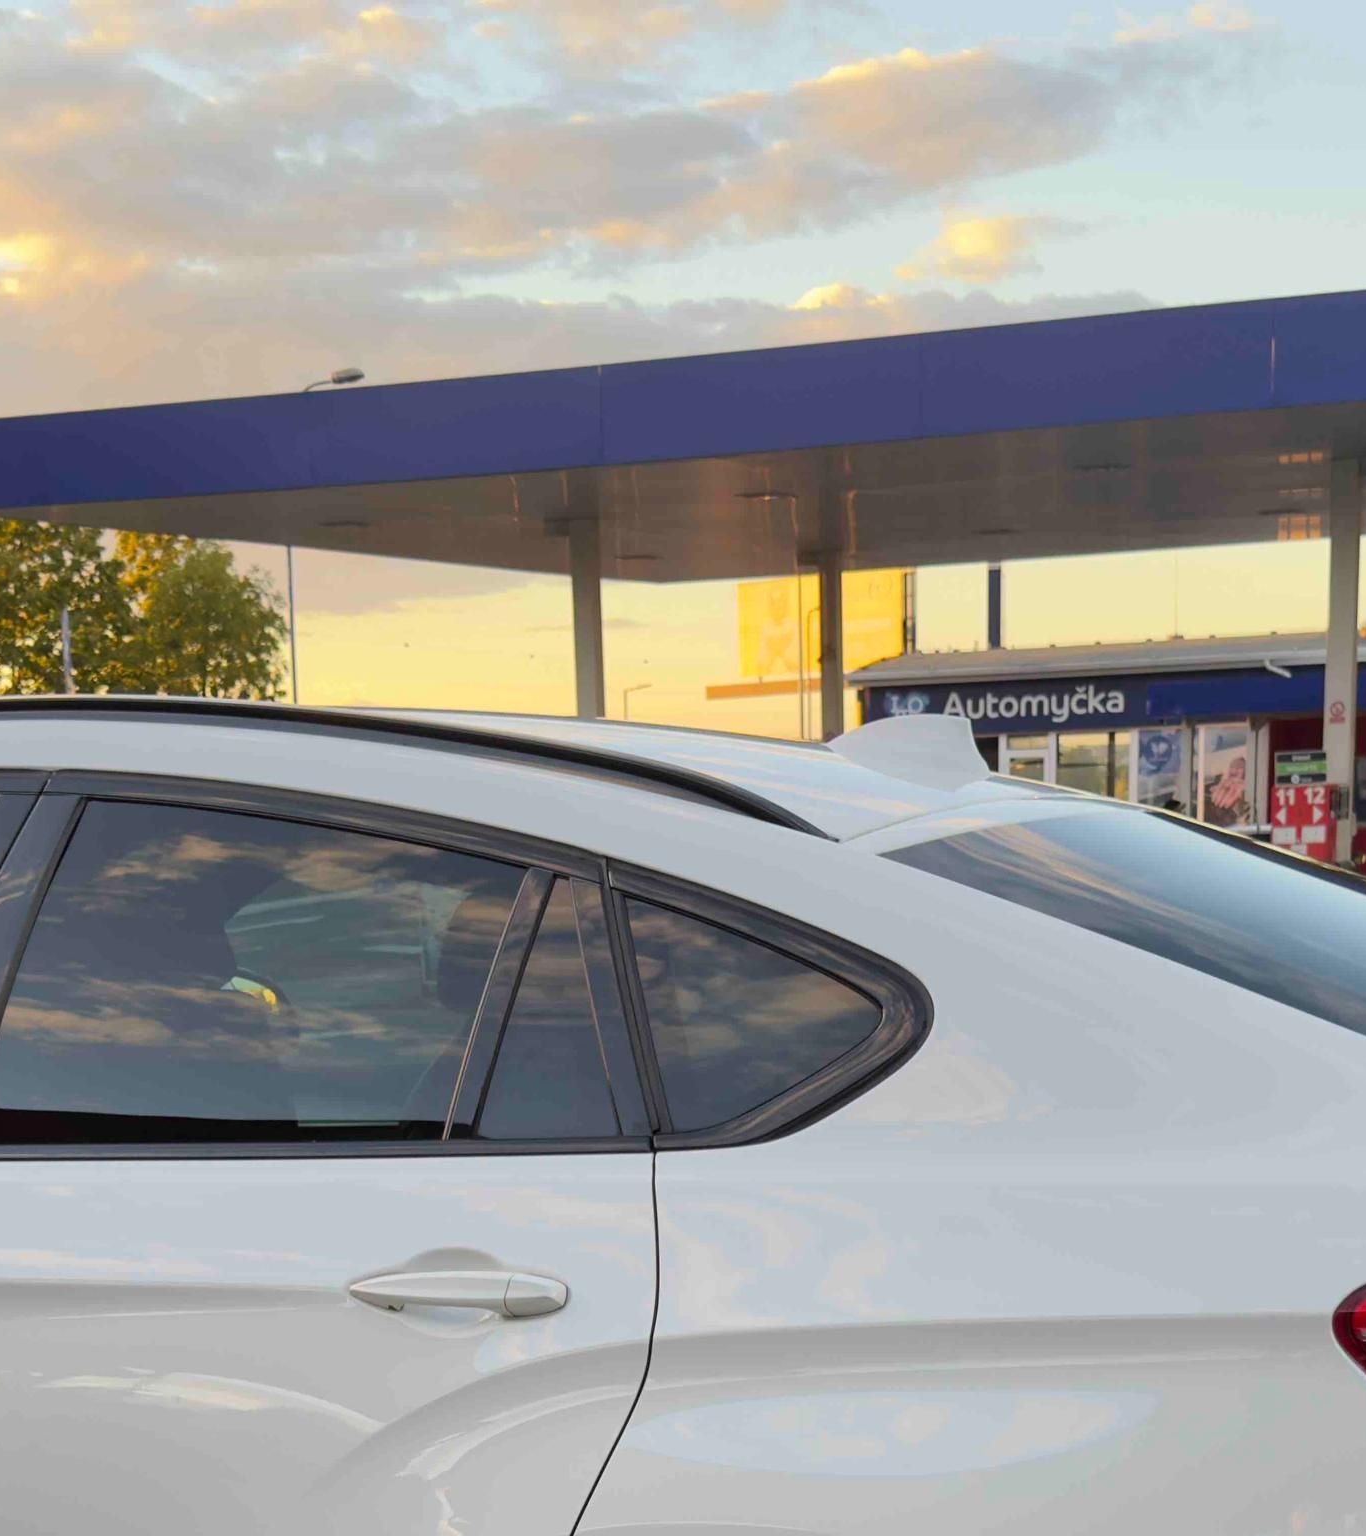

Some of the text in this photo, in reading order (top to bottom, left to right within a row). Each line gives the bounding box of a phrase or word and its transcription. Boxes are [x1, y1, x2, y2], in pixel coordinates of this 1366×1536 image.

[942, 684, 1126, 723] Automyčka
[1275, 788, 1296, 806] 11
[1303, 786, 1326, 805] 12
